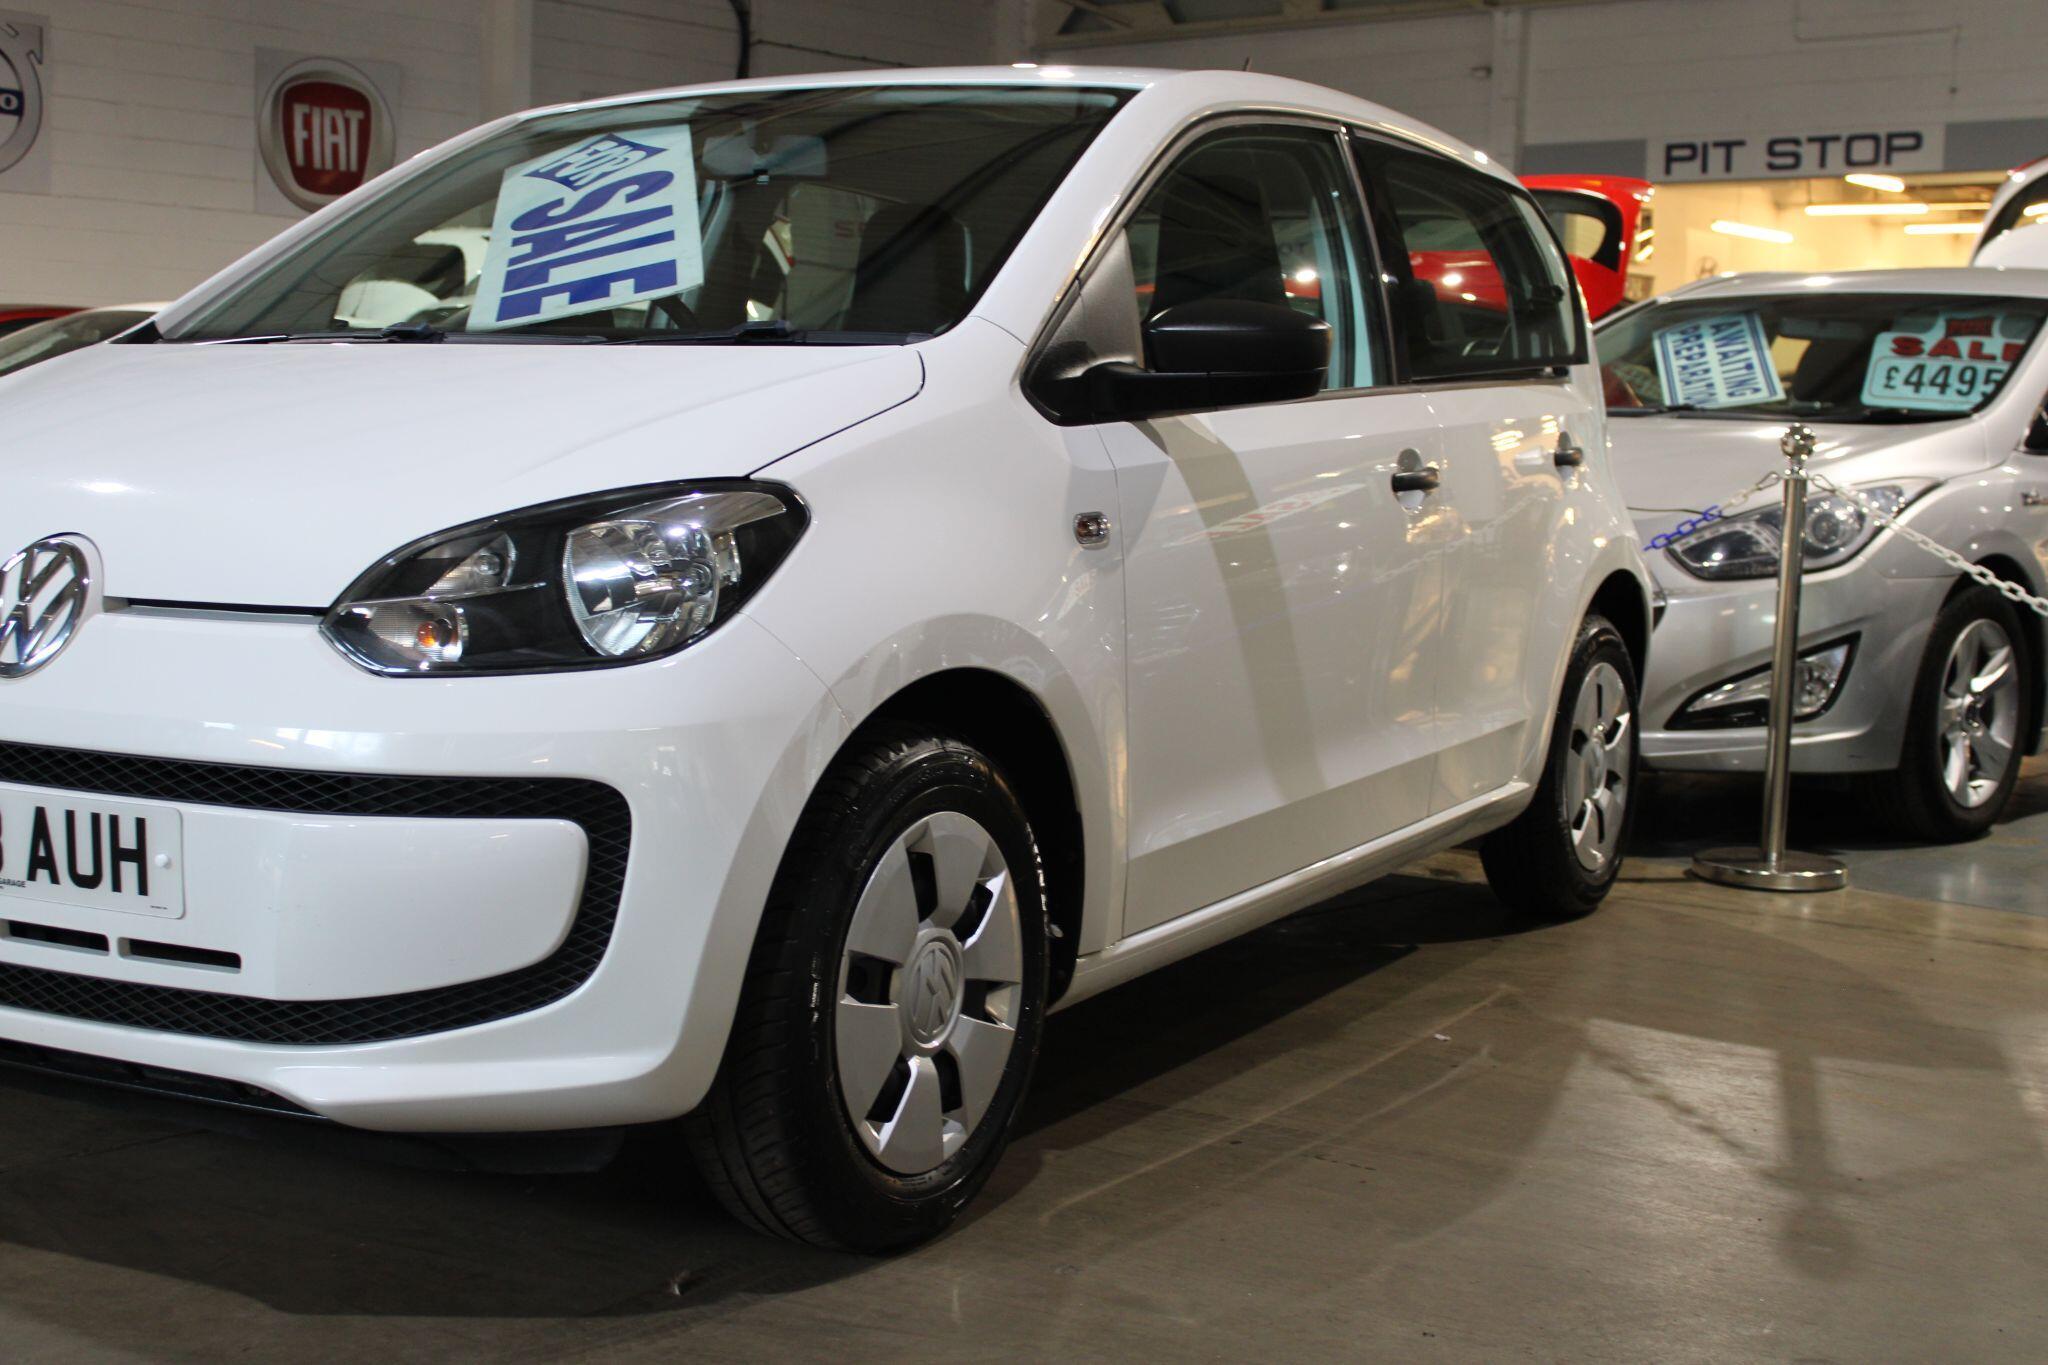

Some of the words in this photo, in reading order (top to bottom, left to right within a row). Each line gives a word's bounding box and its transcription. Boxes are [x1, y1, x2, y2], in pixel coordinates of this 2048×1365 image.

[293, 102, 364, 172] FIAT
[539, 140, 648, 187] FOR
[1665, 140, 1746, 176] PIT
[1766, 131, 1923, 171] STOP
[496, 170, 678, 322] SALE
[1710, 320, 1762, 397] AWAITING
[27, 806, 149, 896] AUH
